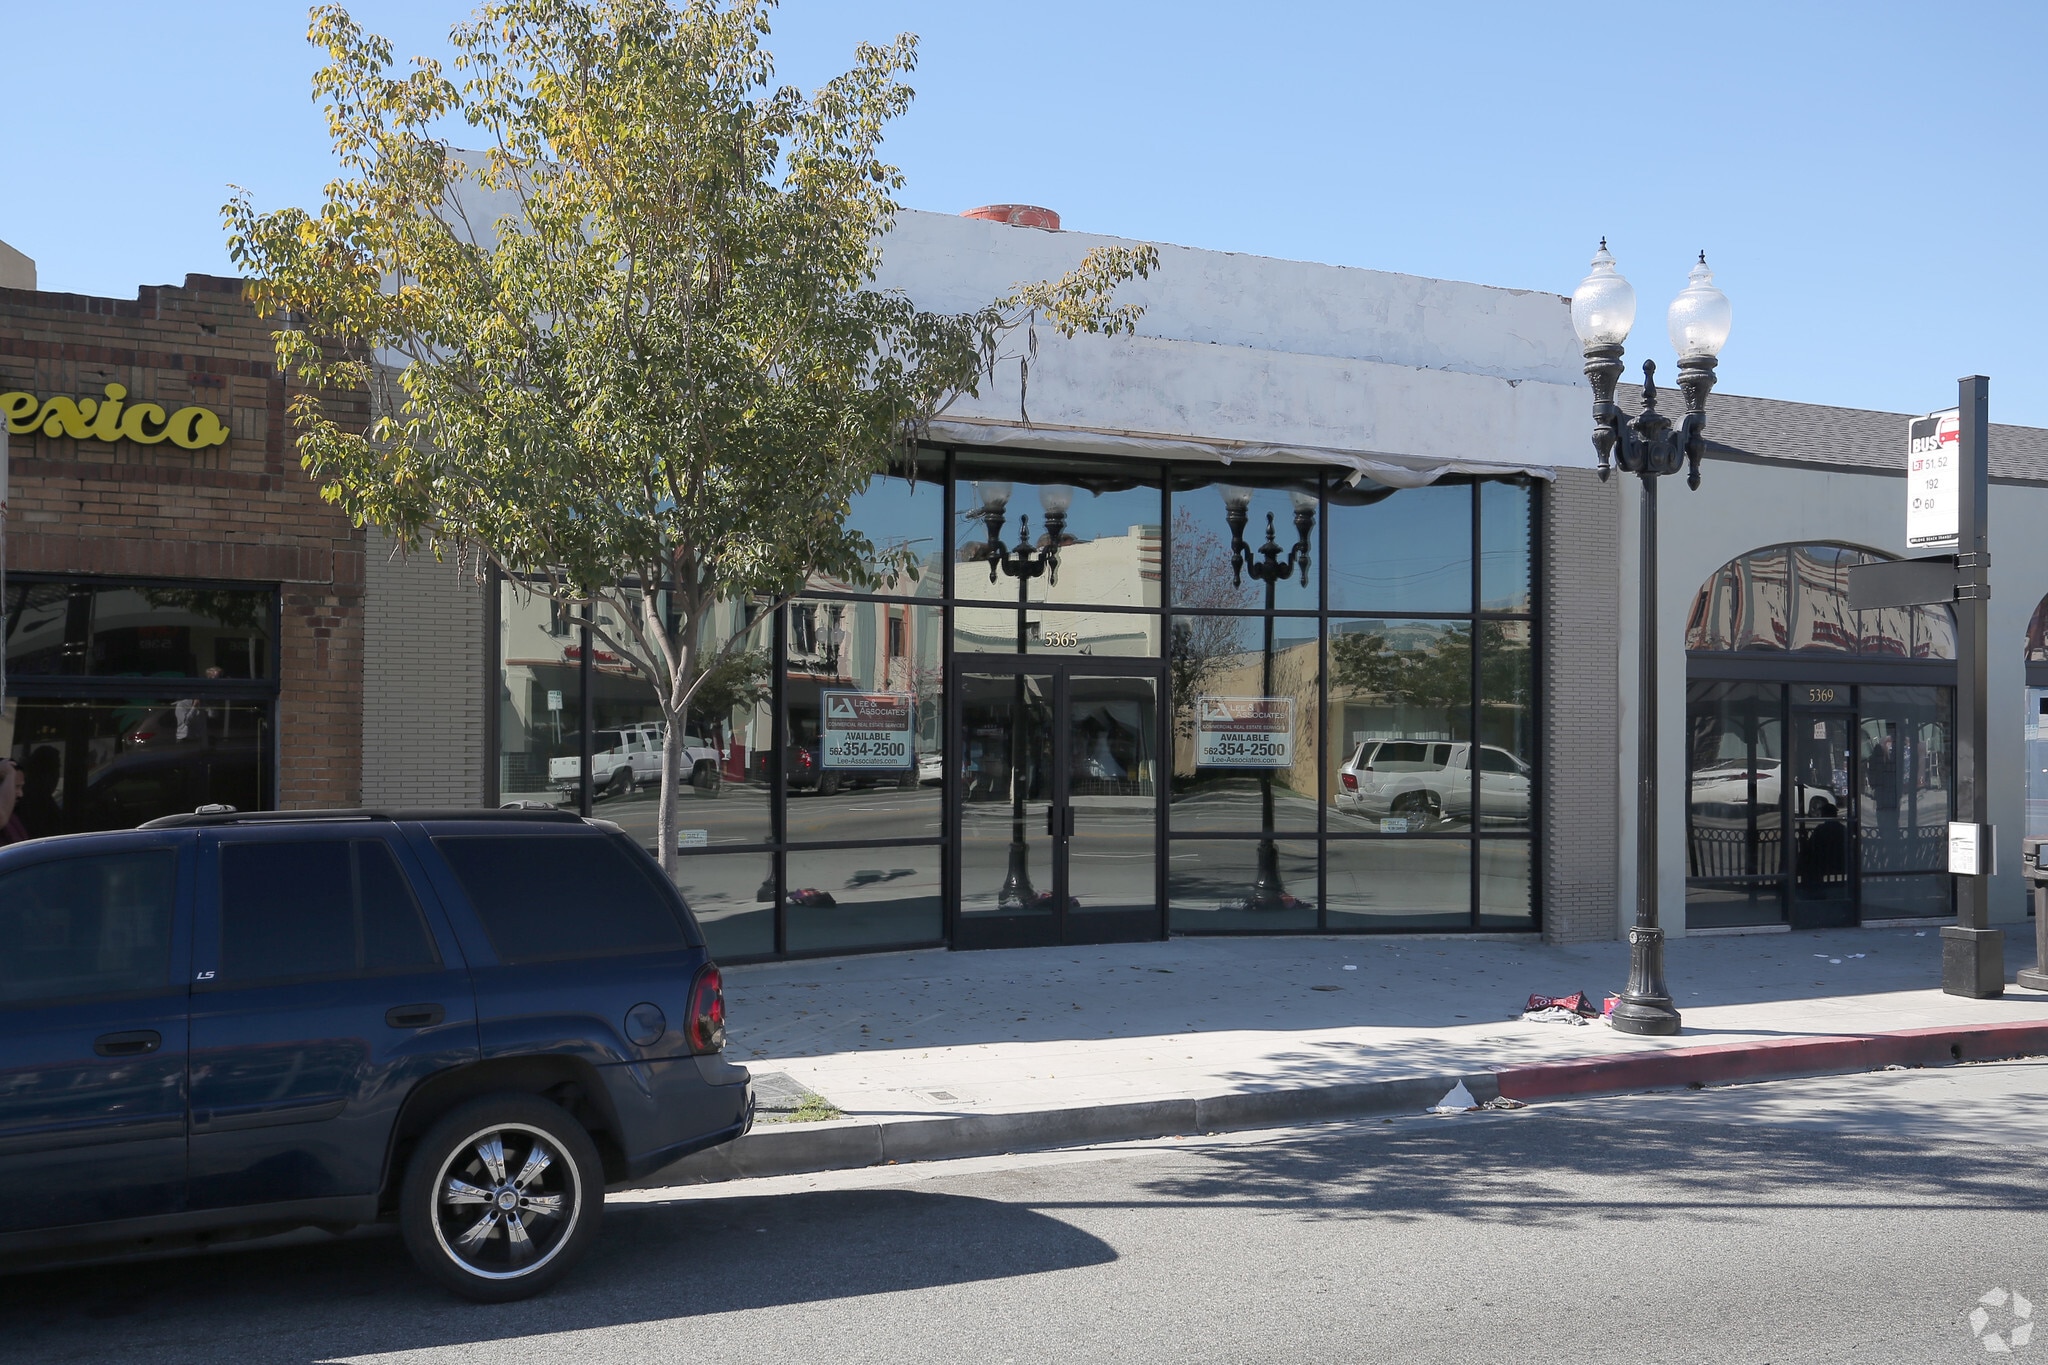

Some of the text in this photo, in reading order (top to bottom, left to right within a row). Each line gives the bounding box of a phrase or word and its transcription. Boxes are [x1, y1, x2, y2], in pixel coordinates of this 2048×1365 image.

[1912, 435, 1938, 454] BUS
[1938, 456, 1948, 468] 52
[1926, 478, 1938, 490] 192
[1924, 498, 1935, 510] 60
[1044, 631, 1078, 647] 5365
[1809, 688, 1834, 702] 5369
[870, 699, 878, 707] &
[860, 708, 906, 716] ASSOCIATES
[829, 742, 905, 756] 562 354-2500
[1219, 743, 1285, 756] 354-2500
[196, 971, 215, 980] LS
